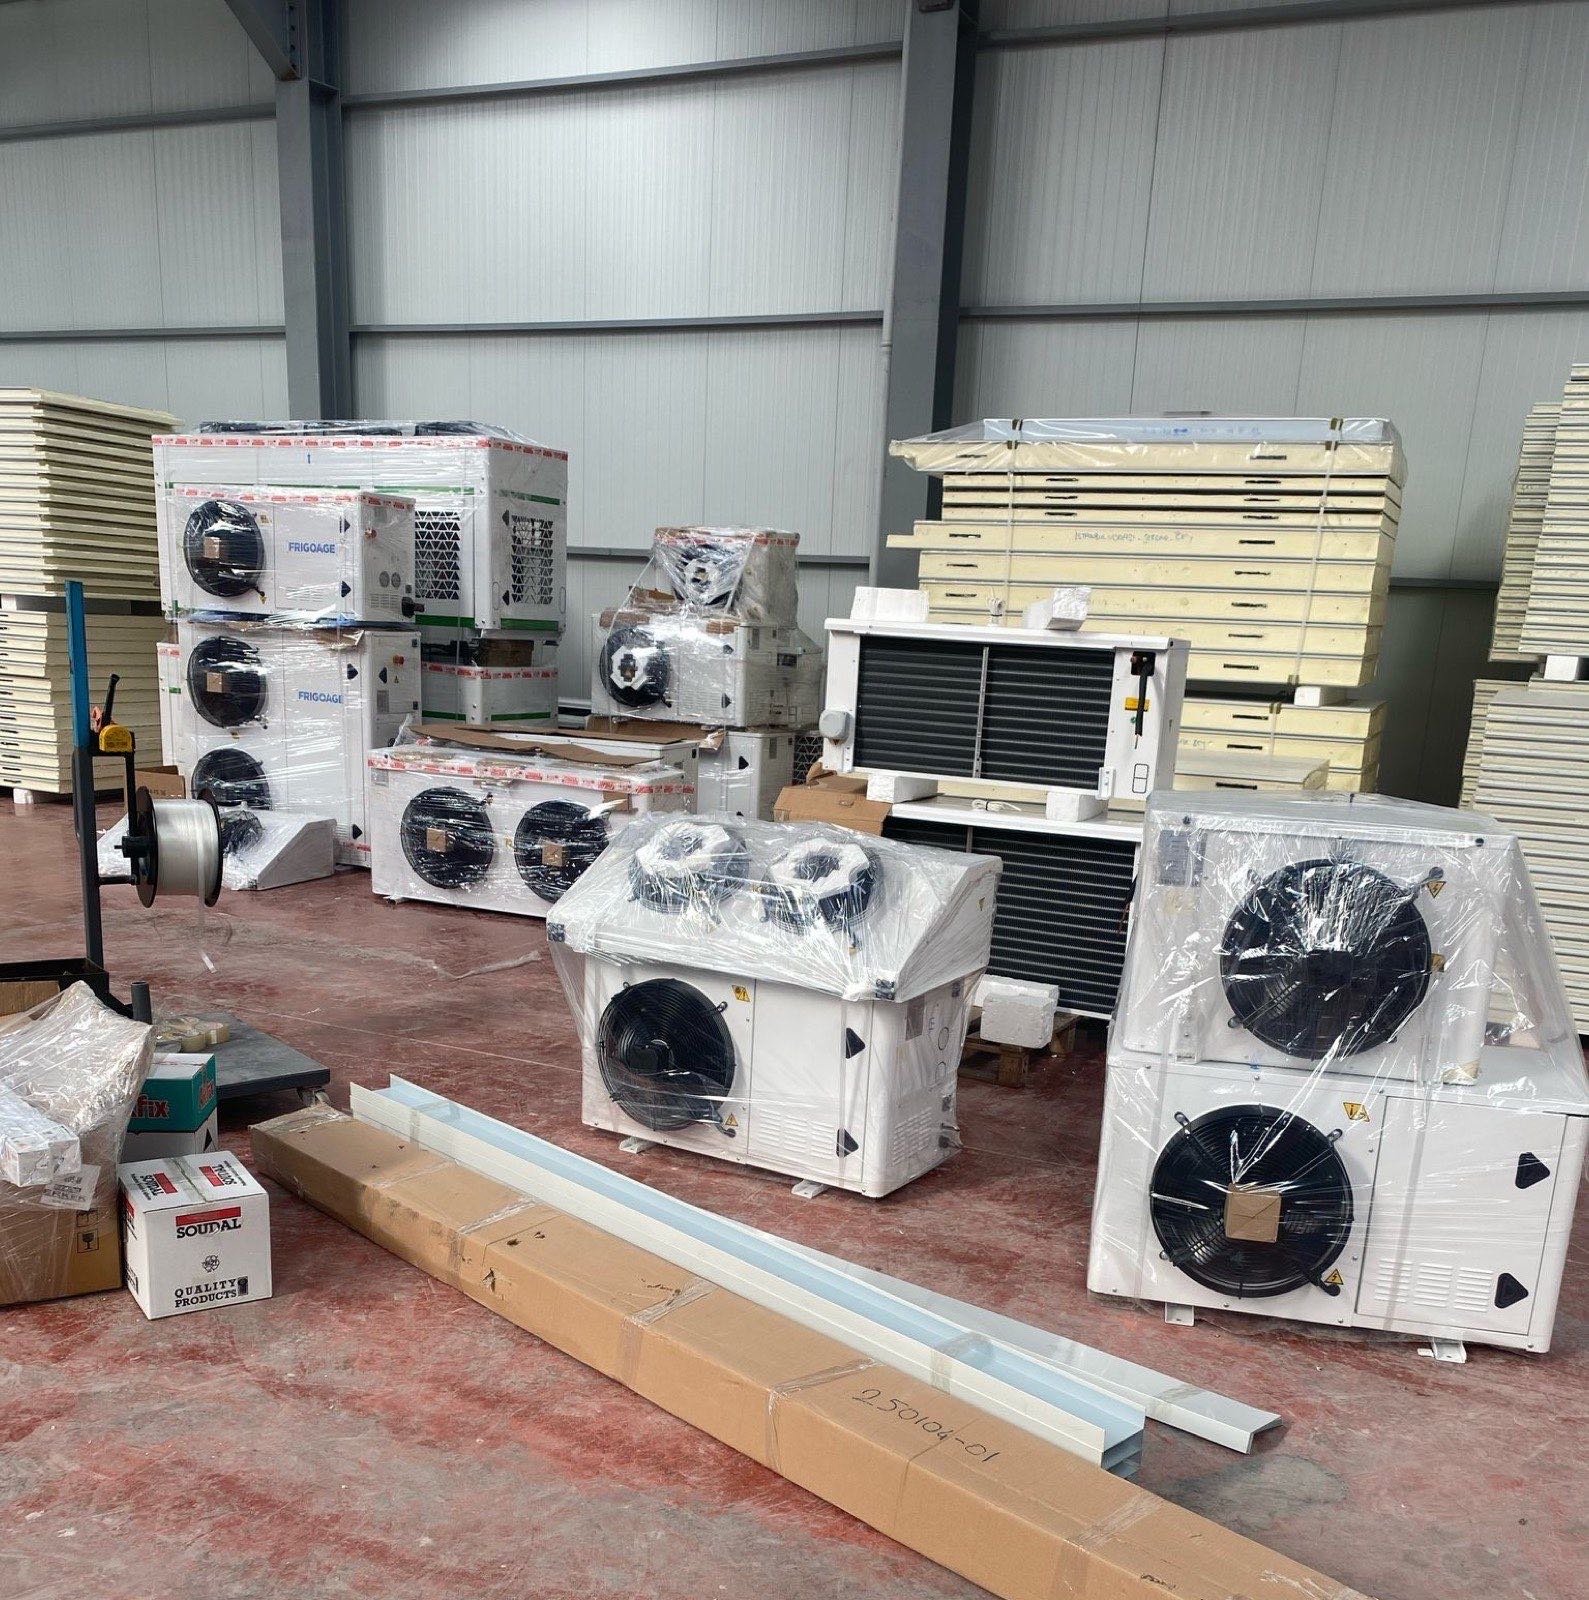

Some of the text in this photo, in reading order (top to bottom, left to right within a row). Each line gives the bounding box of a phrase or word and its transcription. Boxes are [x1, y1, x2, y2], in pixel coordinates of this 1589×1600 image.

[288, 542, 336, 554] FRIGOAGE
[176, 1219, 242, 1239] SOUDAL
[175, 1278, 236, 1298] QUALITY
[175, 1289, 237, 1308] PRODUCTS
[851, 1388, 1000, 1463] 250104-01
